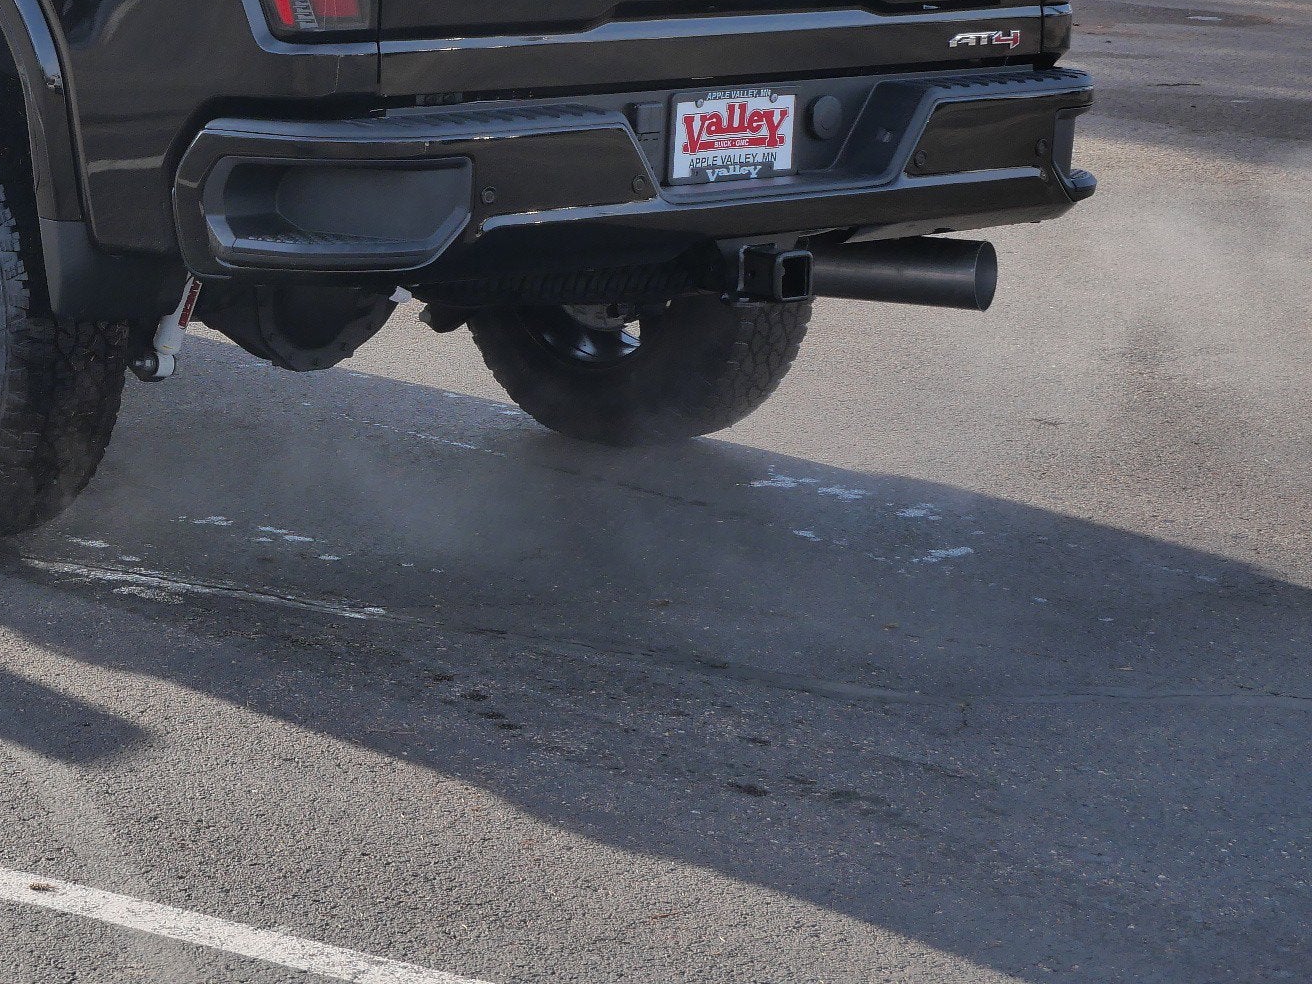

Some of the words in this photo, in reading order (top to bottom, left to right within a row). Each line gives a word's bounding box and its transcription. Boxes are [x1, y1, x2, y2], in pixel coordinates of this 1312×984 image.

[949, 30, 1021, 49] AT4
[706, 91, 729, 101] APPLE
[682, 101, 789, 154] Valley
[714, 140, 732, 148] BUICK
[735, 138, 750, 147] GMC
[689, 155, 718, 168] APPLE
[762, 151, 777, 162] MN
